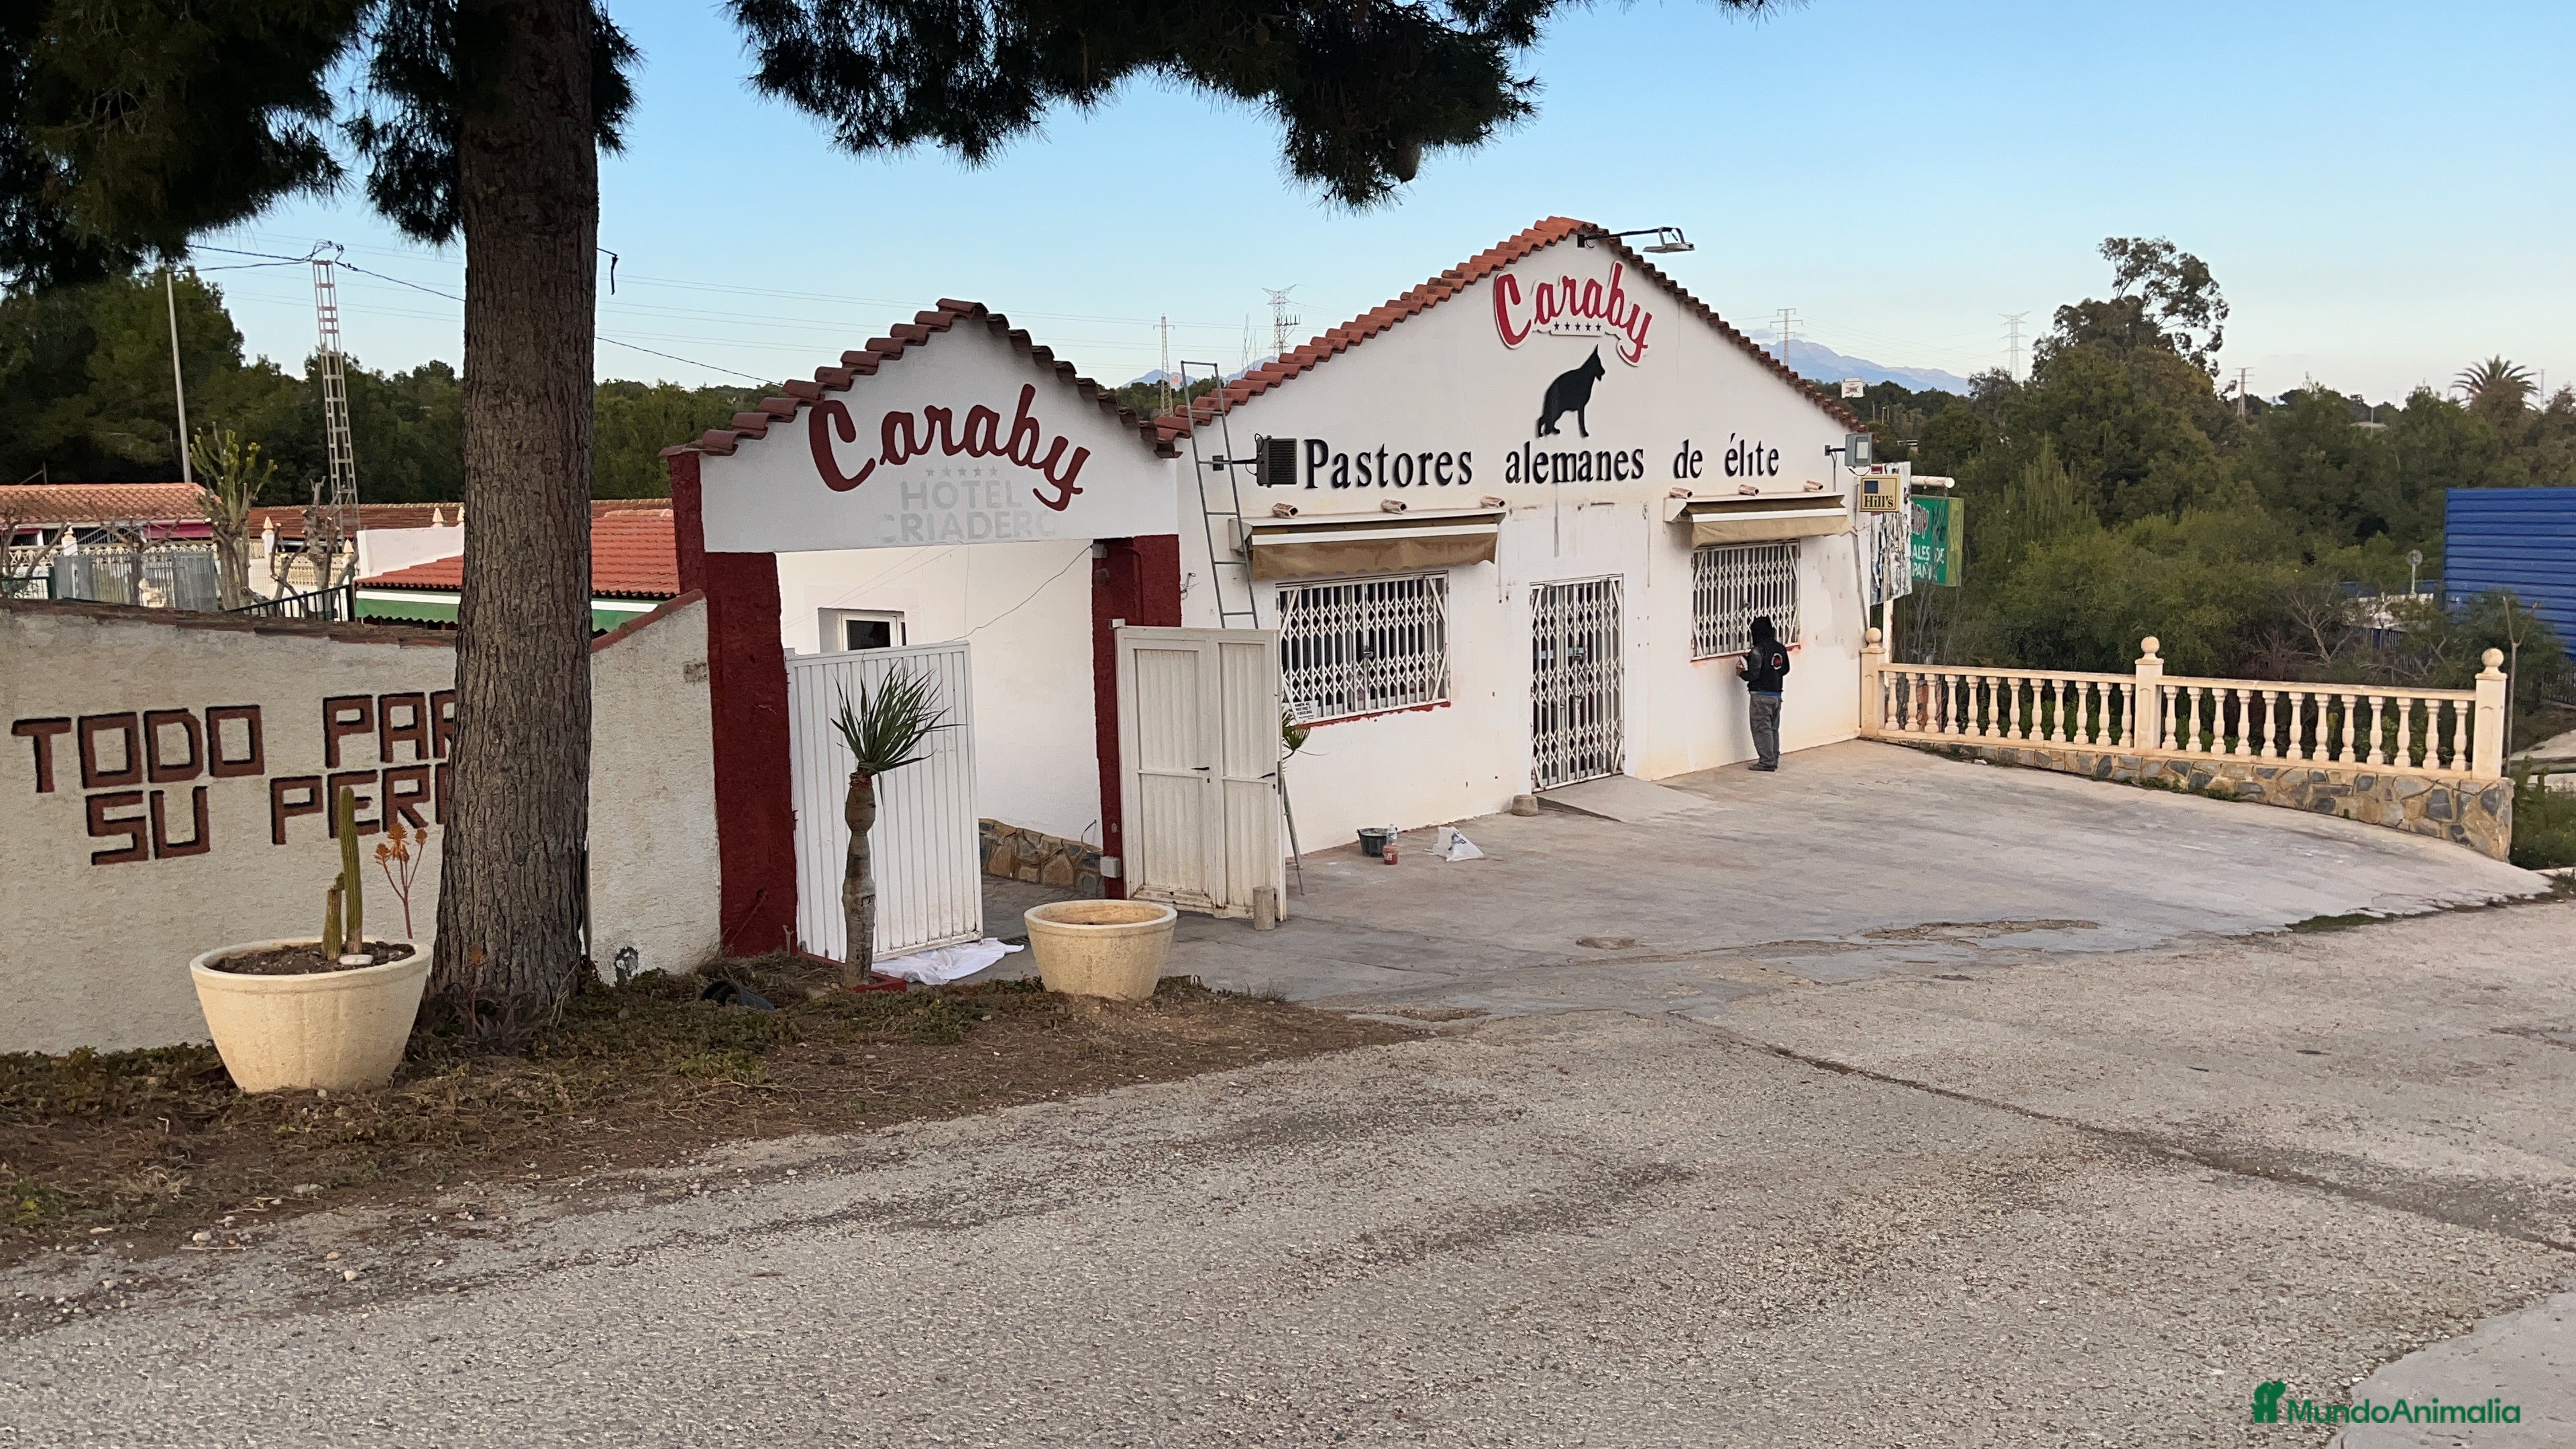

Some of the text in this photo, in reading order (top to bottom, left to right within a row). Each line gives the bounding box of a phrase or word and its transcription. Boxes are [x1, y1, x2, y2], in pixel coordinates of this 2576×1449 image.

[1495, 262, 1652, 364] Caraby
[809, 383, 1091, 511] Caraby
[1304, 432, 1780, 489] Pastores alemanes de élite
[900, 480, 1023, 511] HOTEL
[1864, 495, 1894, 508] Hill's
[11, 704, 265, 794] TODO
[85, 786, 211, 866] SU
